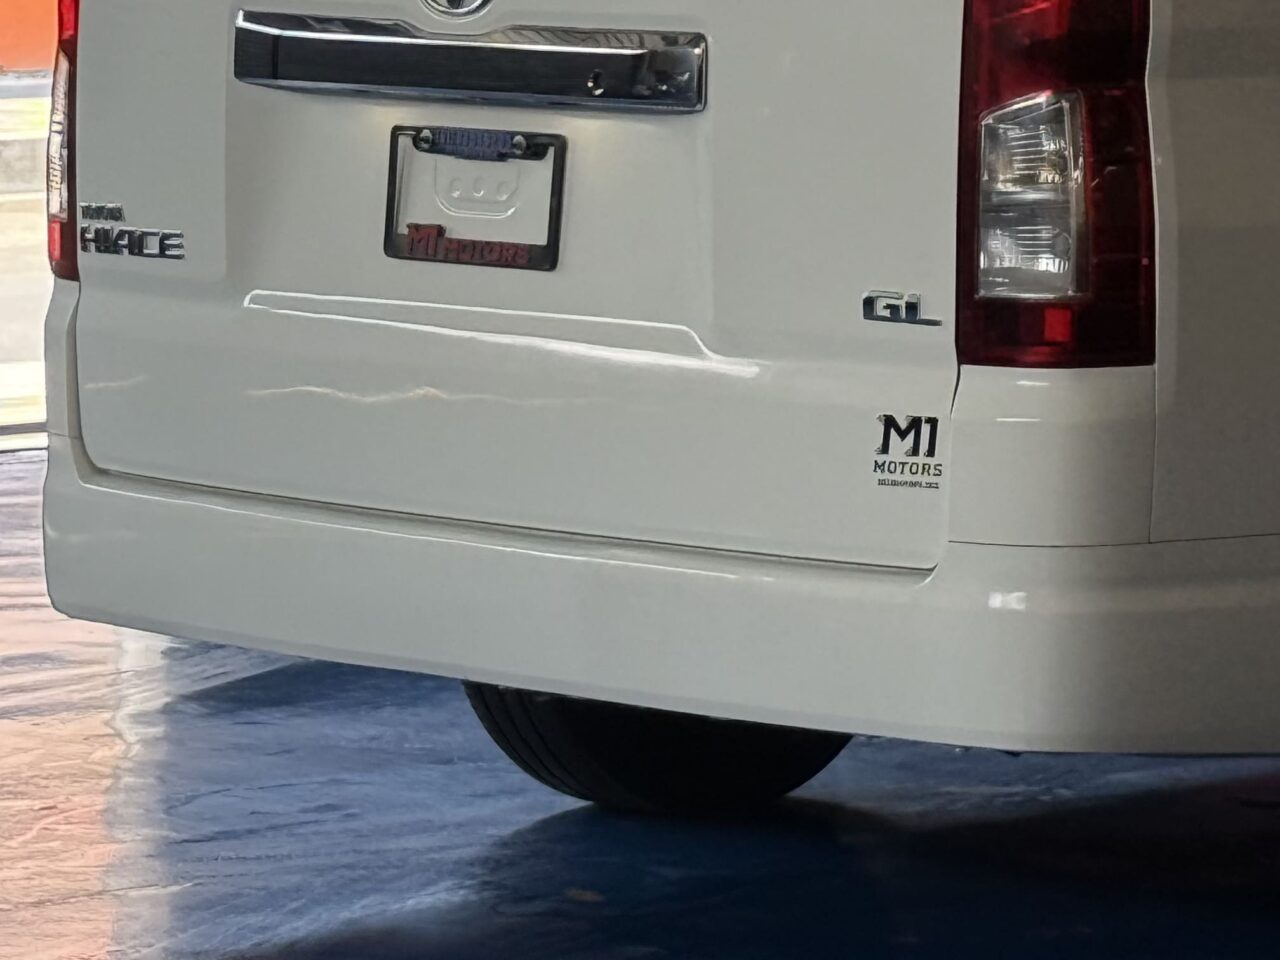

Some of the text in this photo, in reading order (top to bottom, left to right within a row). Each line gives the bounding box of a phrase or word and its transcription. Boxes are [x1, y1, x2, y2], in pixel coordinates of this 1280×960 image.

[80, 224, 184, 259] HIACE
[862, 290, 942, 326] GL
[875, 414, 939, 458] M1
[873, 460, 943, 477] MOTORS
